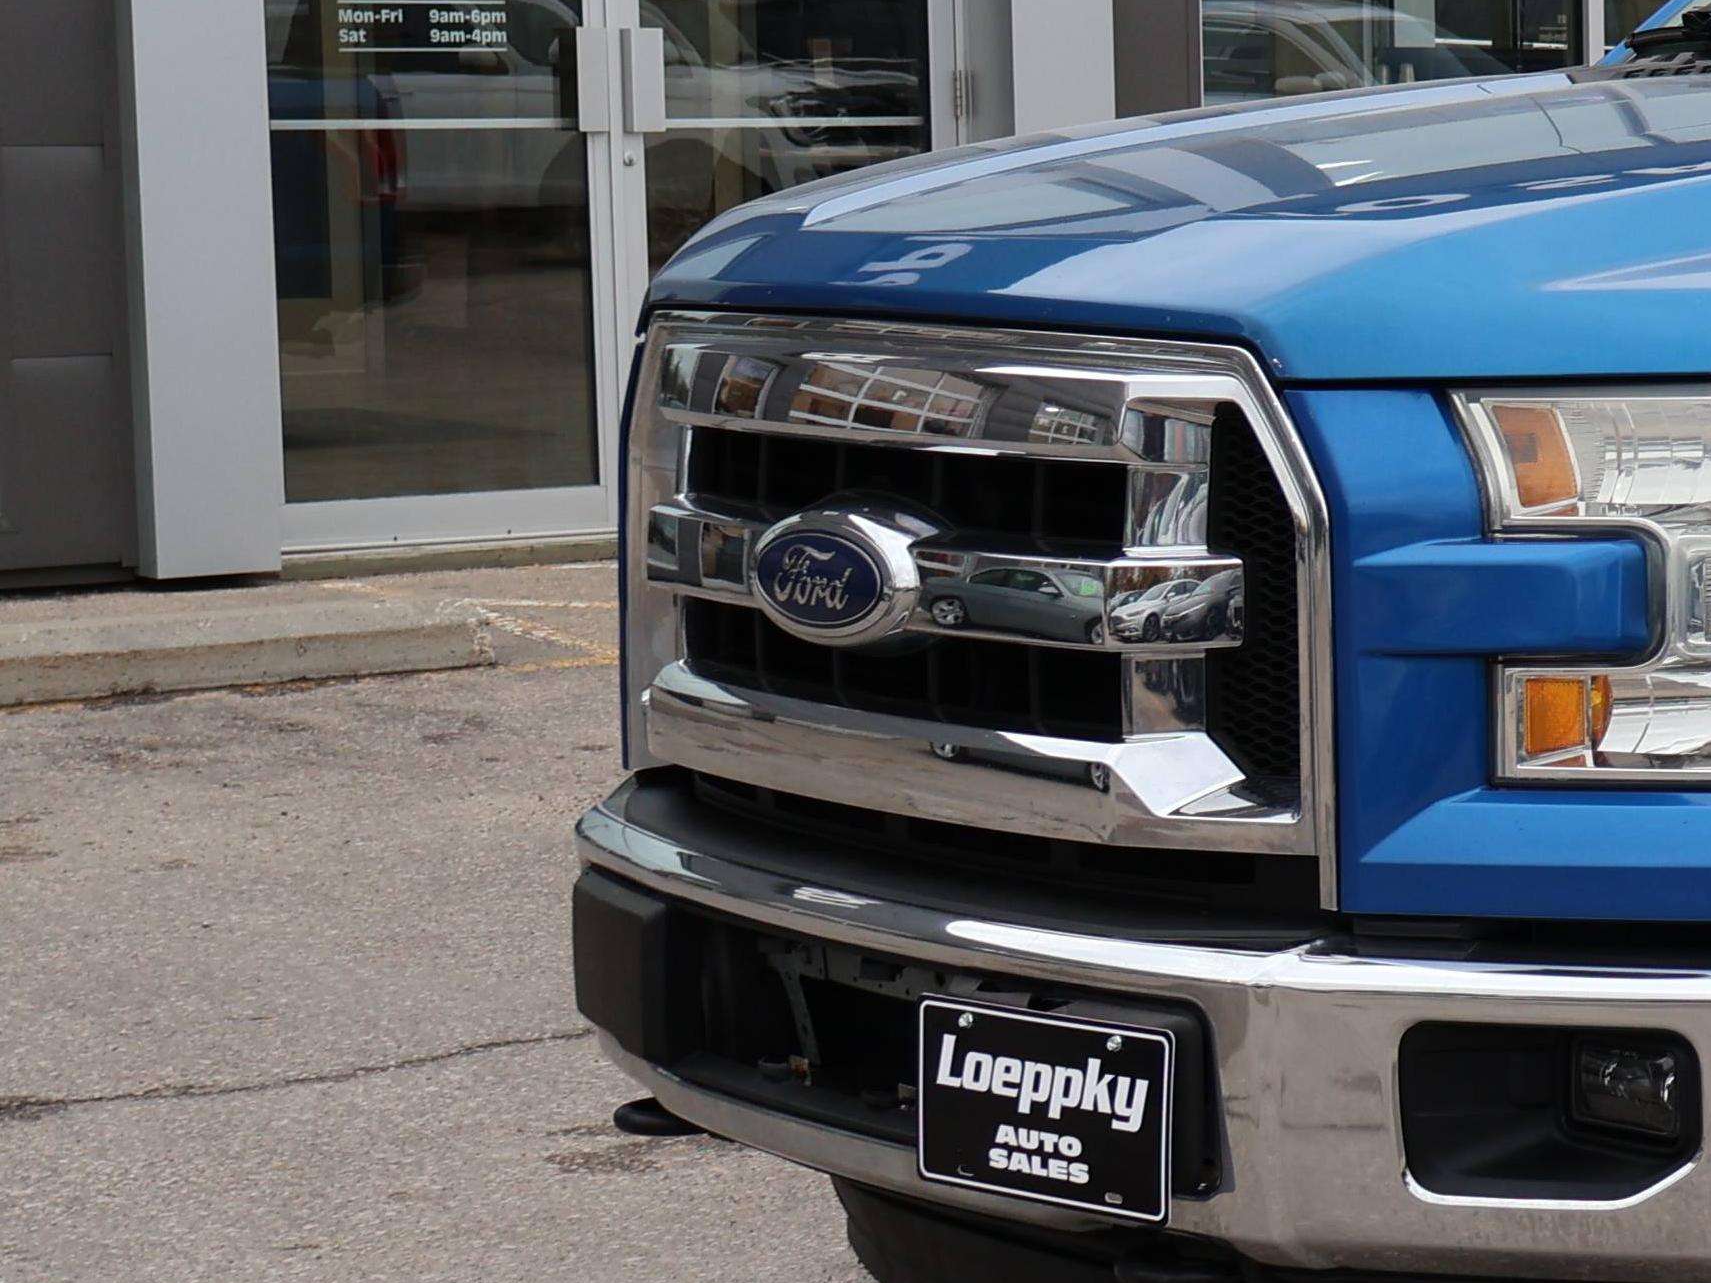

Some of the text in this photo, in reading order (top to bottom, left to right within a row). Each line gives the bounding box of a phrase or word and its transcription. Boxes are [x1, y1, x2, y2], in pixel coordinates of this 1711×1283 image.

[338, 9, 506, 26] Mon-Fri 9am-6pm
[339, 28, 507, 45] Sat 9am-4pm
[774, 544, 852, 610] Ford
[936, 1033, 1149, 1133] Loeppky
[995, 1124, 1082, 1157] AUTO
[989, 1148, 1090, 1184] SALES
